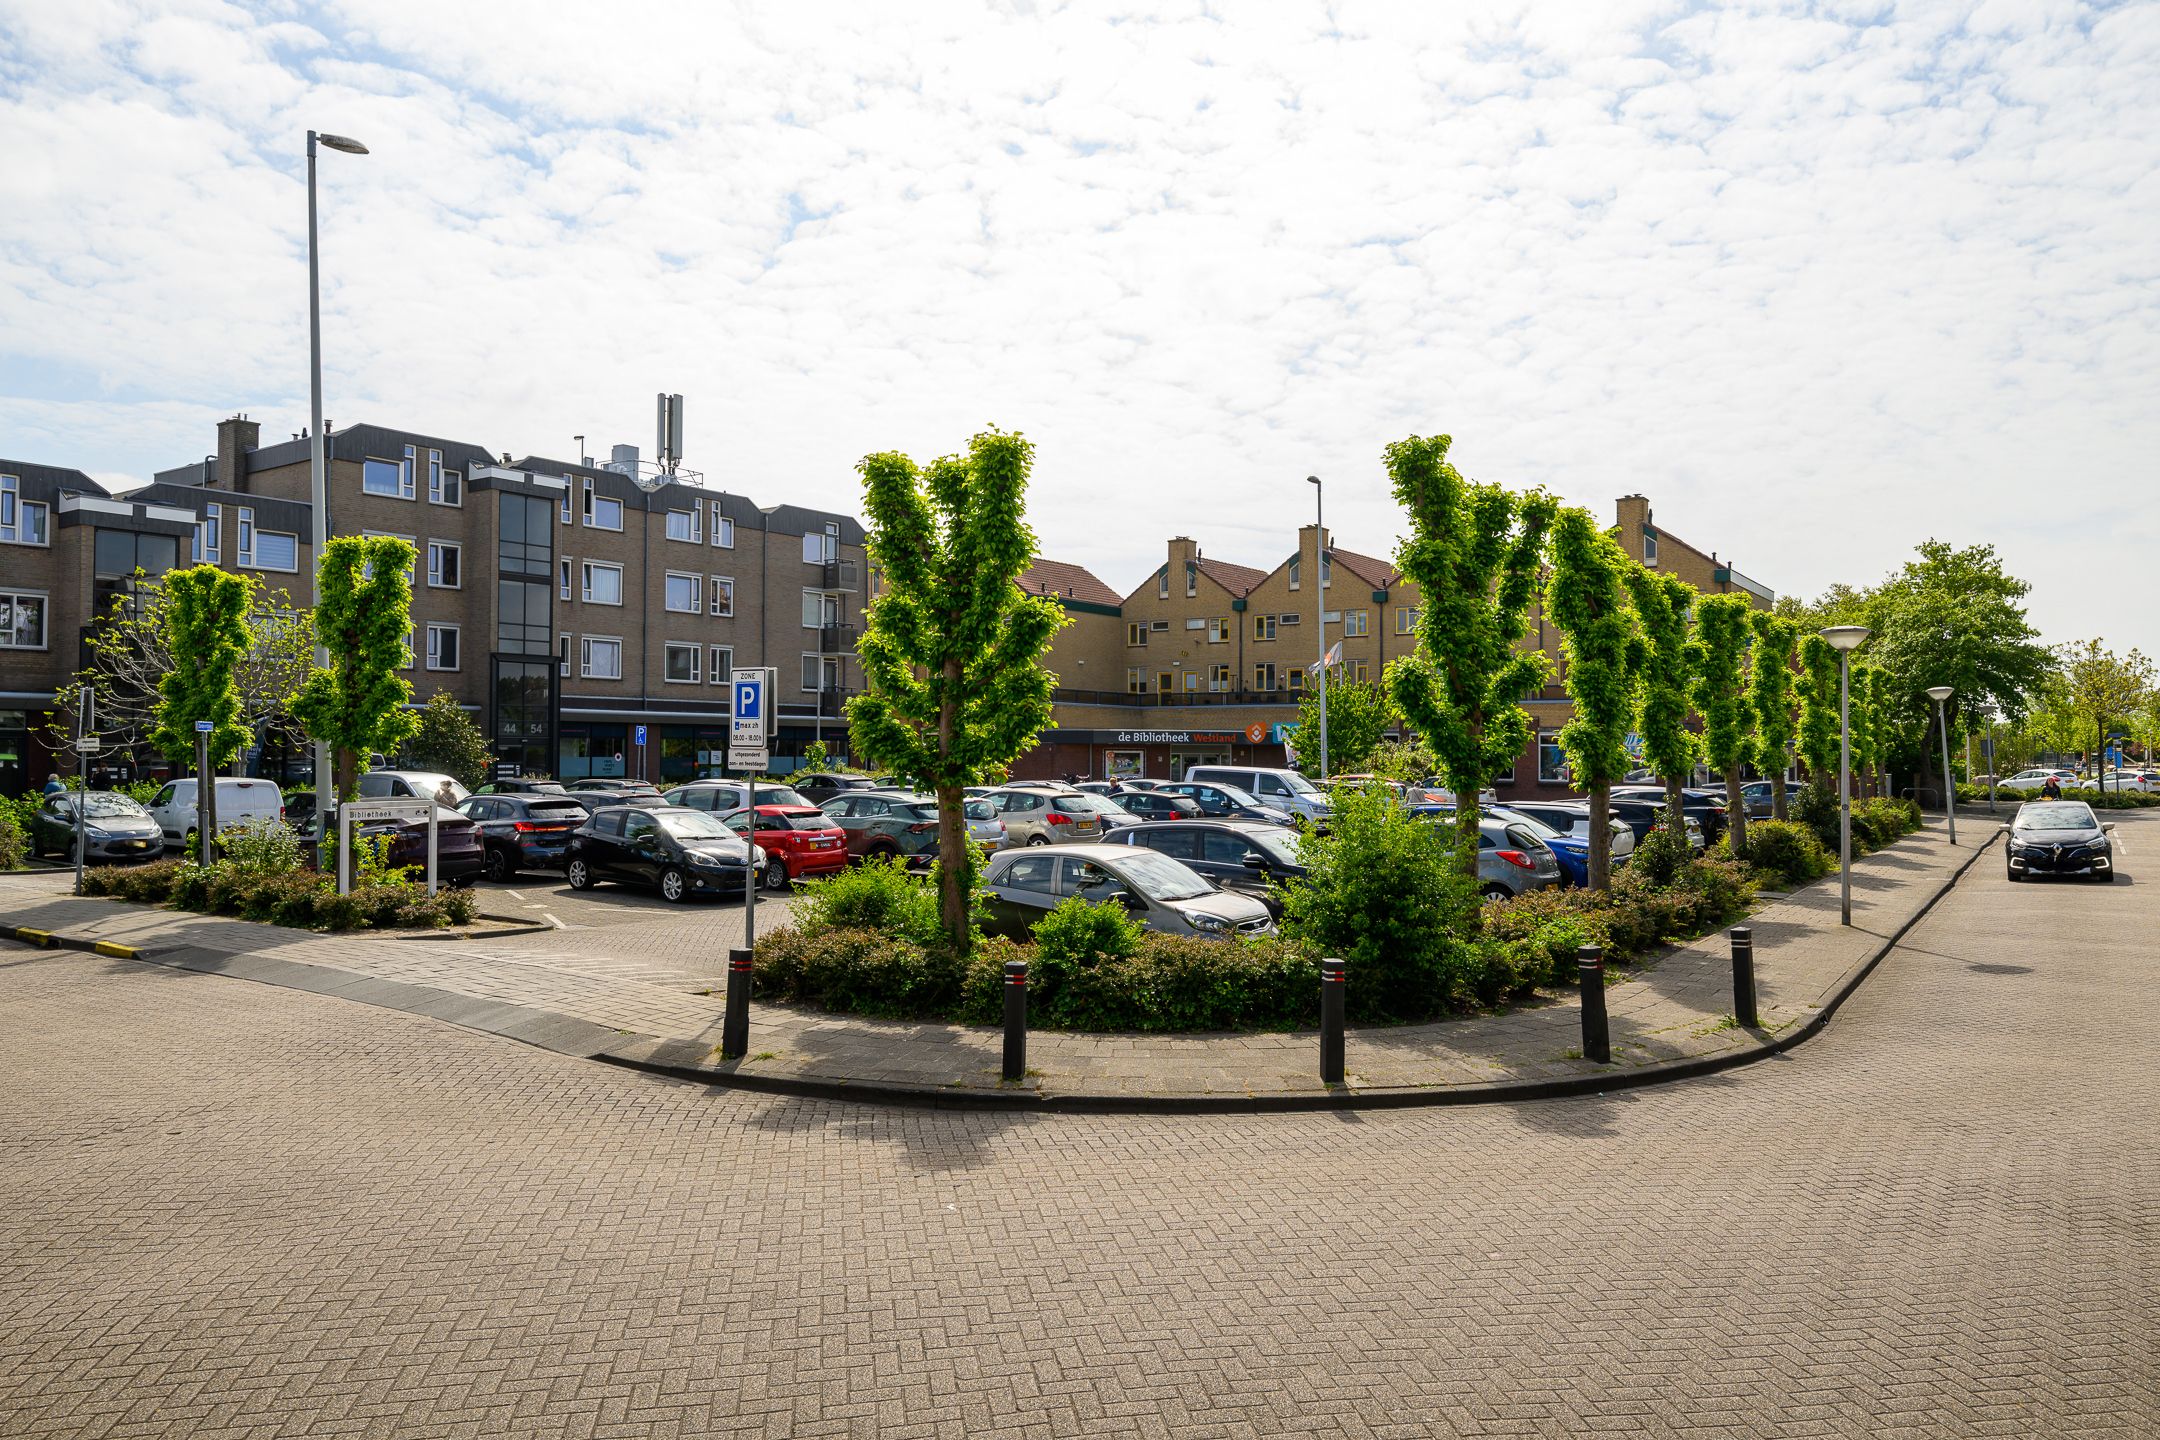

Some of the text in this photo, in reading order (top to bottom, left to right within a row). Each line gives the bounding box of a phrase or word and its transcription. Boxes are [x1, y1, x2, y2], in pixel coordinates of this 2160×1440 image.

[741, 687, 755, 715] P
[504, 723, 516, 733] 44
[530, 724, 542, 734] 54
[639, 727, 645, 737] P
[1118, 732, 1237, 743] de Bibliotheek Westland
